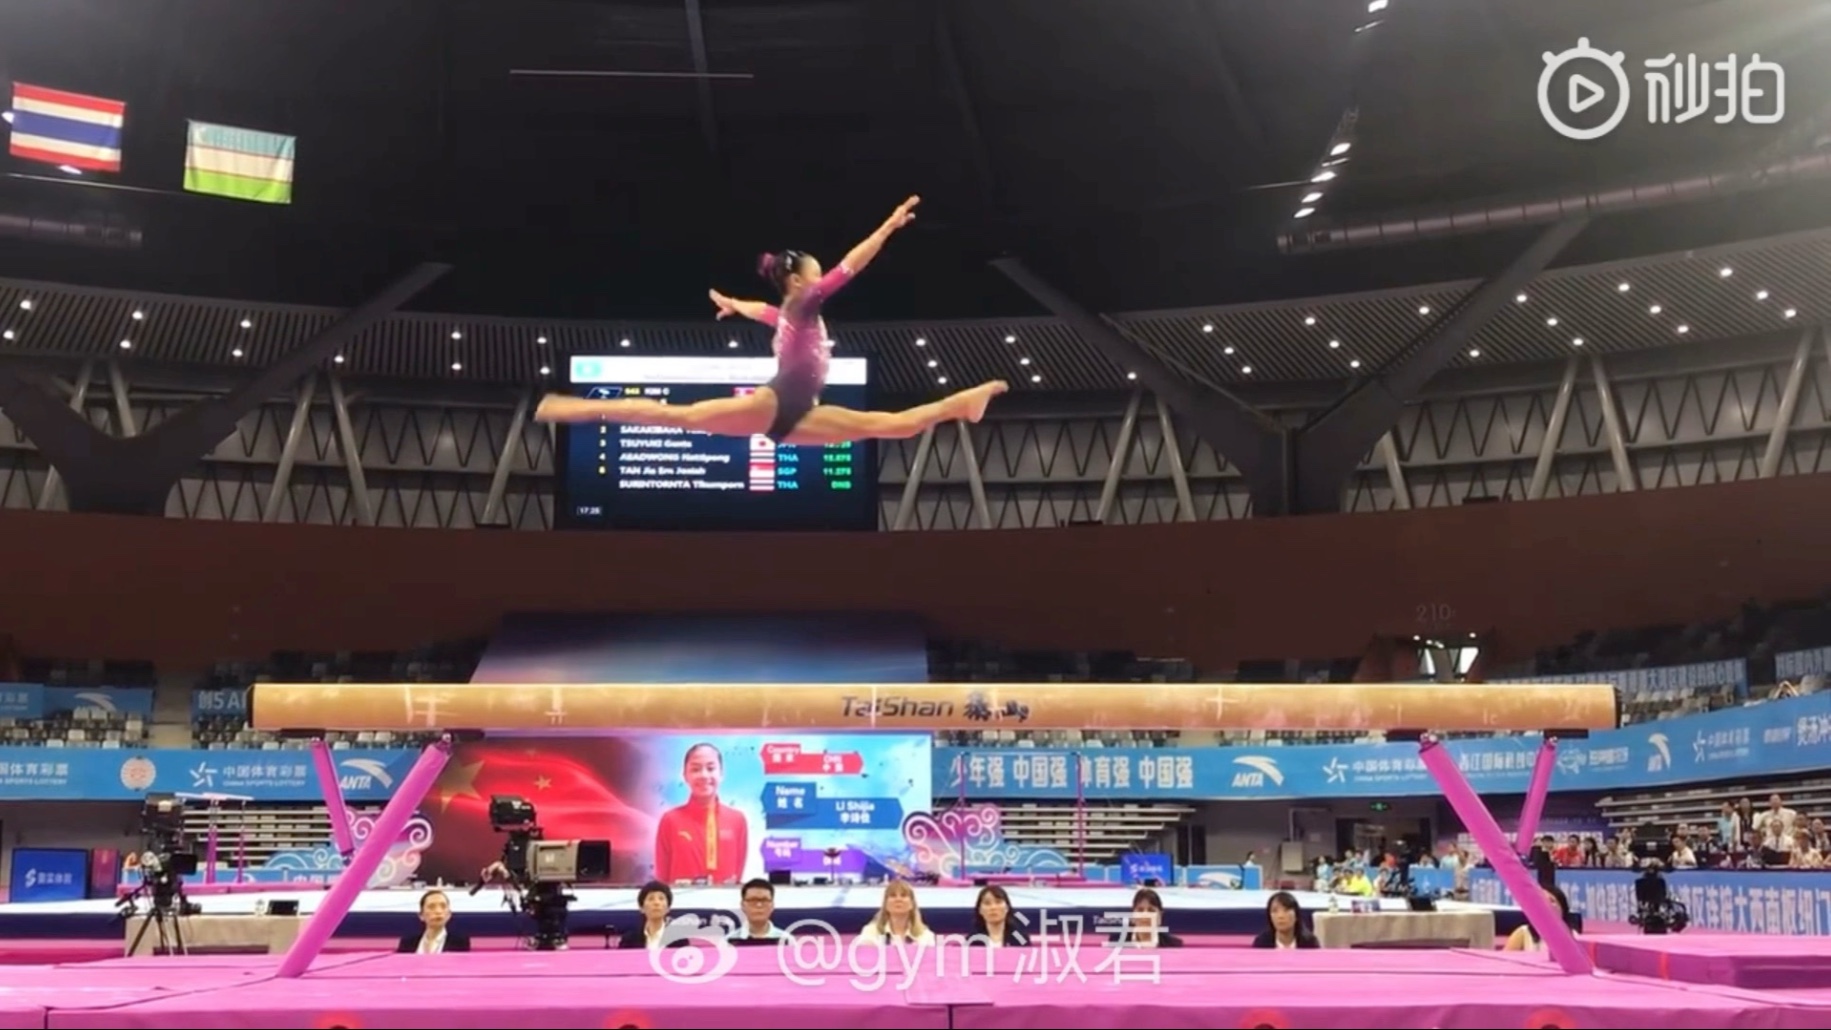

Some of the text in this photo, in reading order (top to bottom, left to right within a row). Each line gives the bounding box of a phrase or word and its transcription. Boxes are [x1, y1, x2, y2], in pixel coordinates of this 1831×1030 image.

[777, 453, 798, 462] THA
[619, 466, 641, 475] TAN
[777, 480, 798, 489] THA
[841, 696, 954, 717] TaiShan
[223, 765, 307, 778] 中国体育彩票
[1013, 755, 1067, 788] 中国强
[1139, 755, 1193, 789] 中国强
[340, 776, 372, 790] ANTA
[1231, 772, 1264, 787] ANTA
[776, 786, 805, 795] Name
